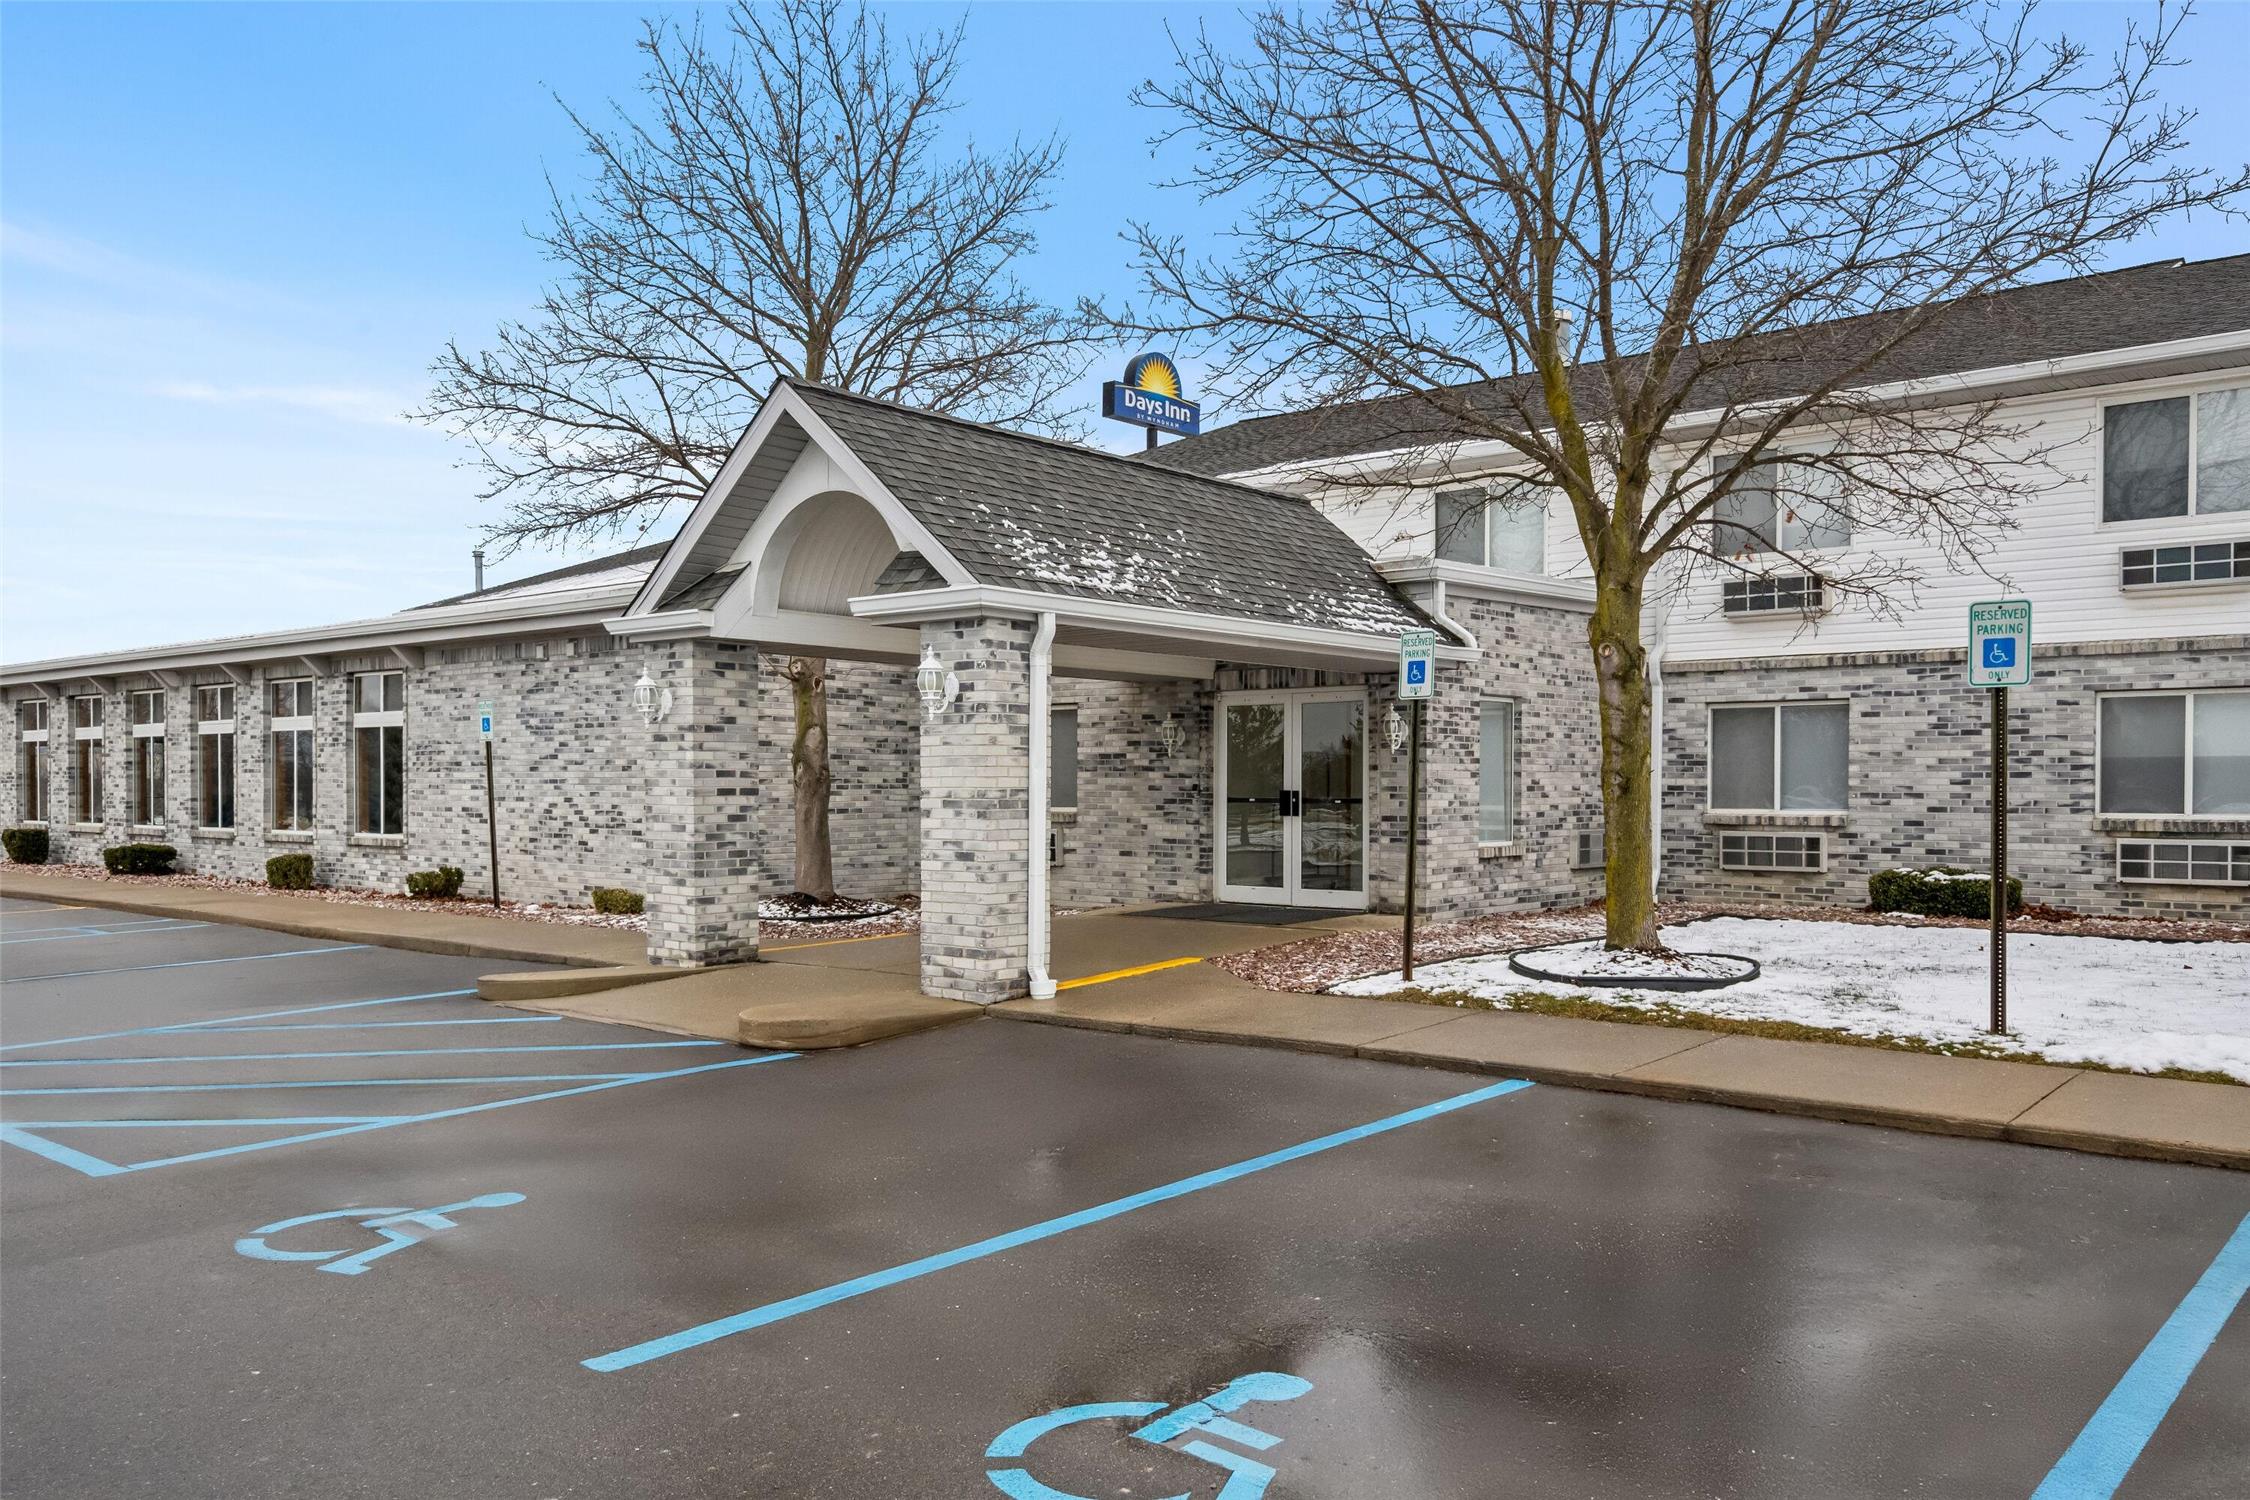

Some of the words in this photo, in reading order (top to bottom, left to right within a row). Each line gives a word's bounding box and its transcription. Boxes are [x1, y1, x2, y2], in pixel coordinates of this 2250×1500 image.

[1124, 389, 1163, 415] Days
[1165, 400, 1191, 422] Inn
[1147, 416, 1180, 428] WYNDHAM
[1973, 608, 2028, 621] RESERVED
[1976, 623, 2024, 635] PARKING
[1403, 637, 1433, 647] RESERVED
[1404, 649, 1431, 658] PARKING
[1988, 671, 2010, 680] ONLY
